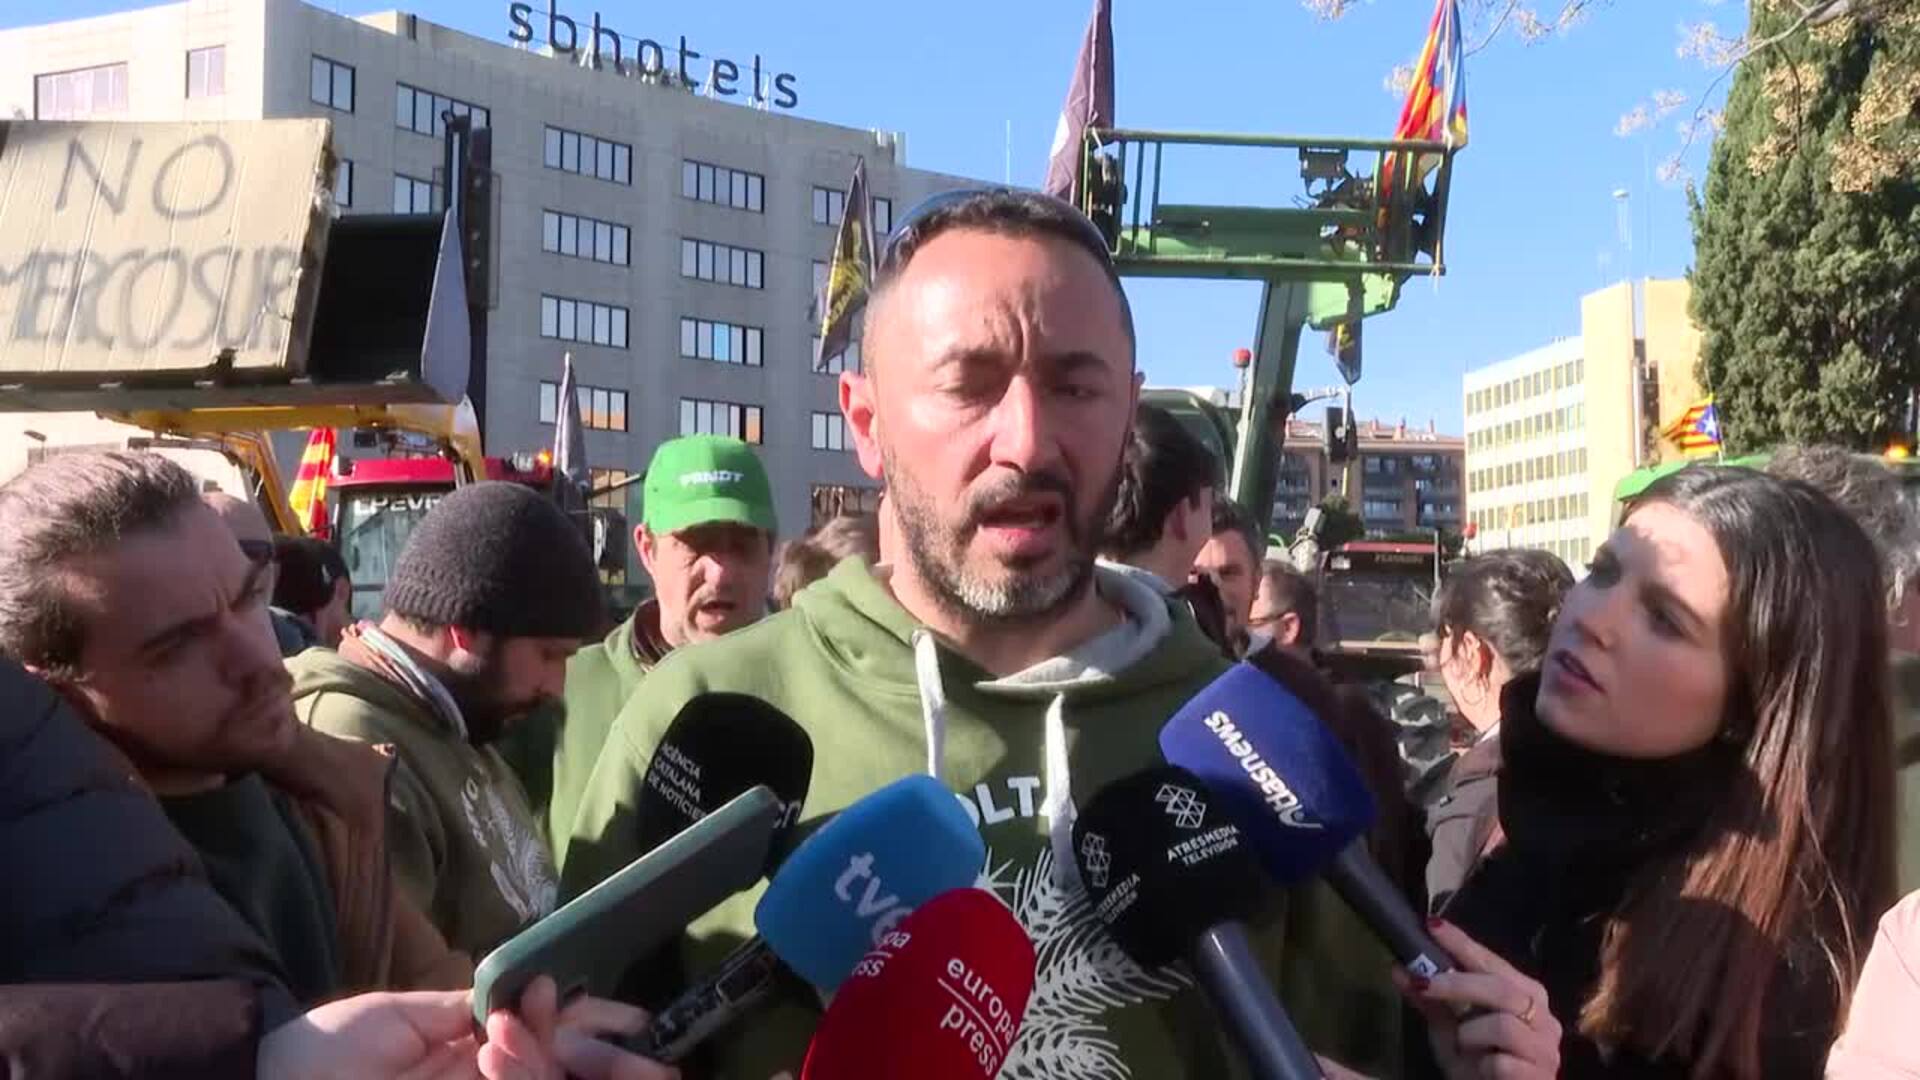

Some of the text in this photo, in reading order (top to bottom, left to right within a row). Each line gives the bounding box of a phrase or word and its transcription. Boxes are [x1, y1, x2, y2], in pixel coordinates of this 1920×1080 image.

[55, 134, 235, 221] NO
[0, 244, 302, 350] MERCOSUR
[653, 756, 701, 801] CATALANA
[660, 781, 708, 821] NOTÍCIE
[1166, 824, 1240, 863] ATRESMEDIA
[946, 957, 1015, 1045] europa
[940, 1003, 998, 1077] press
